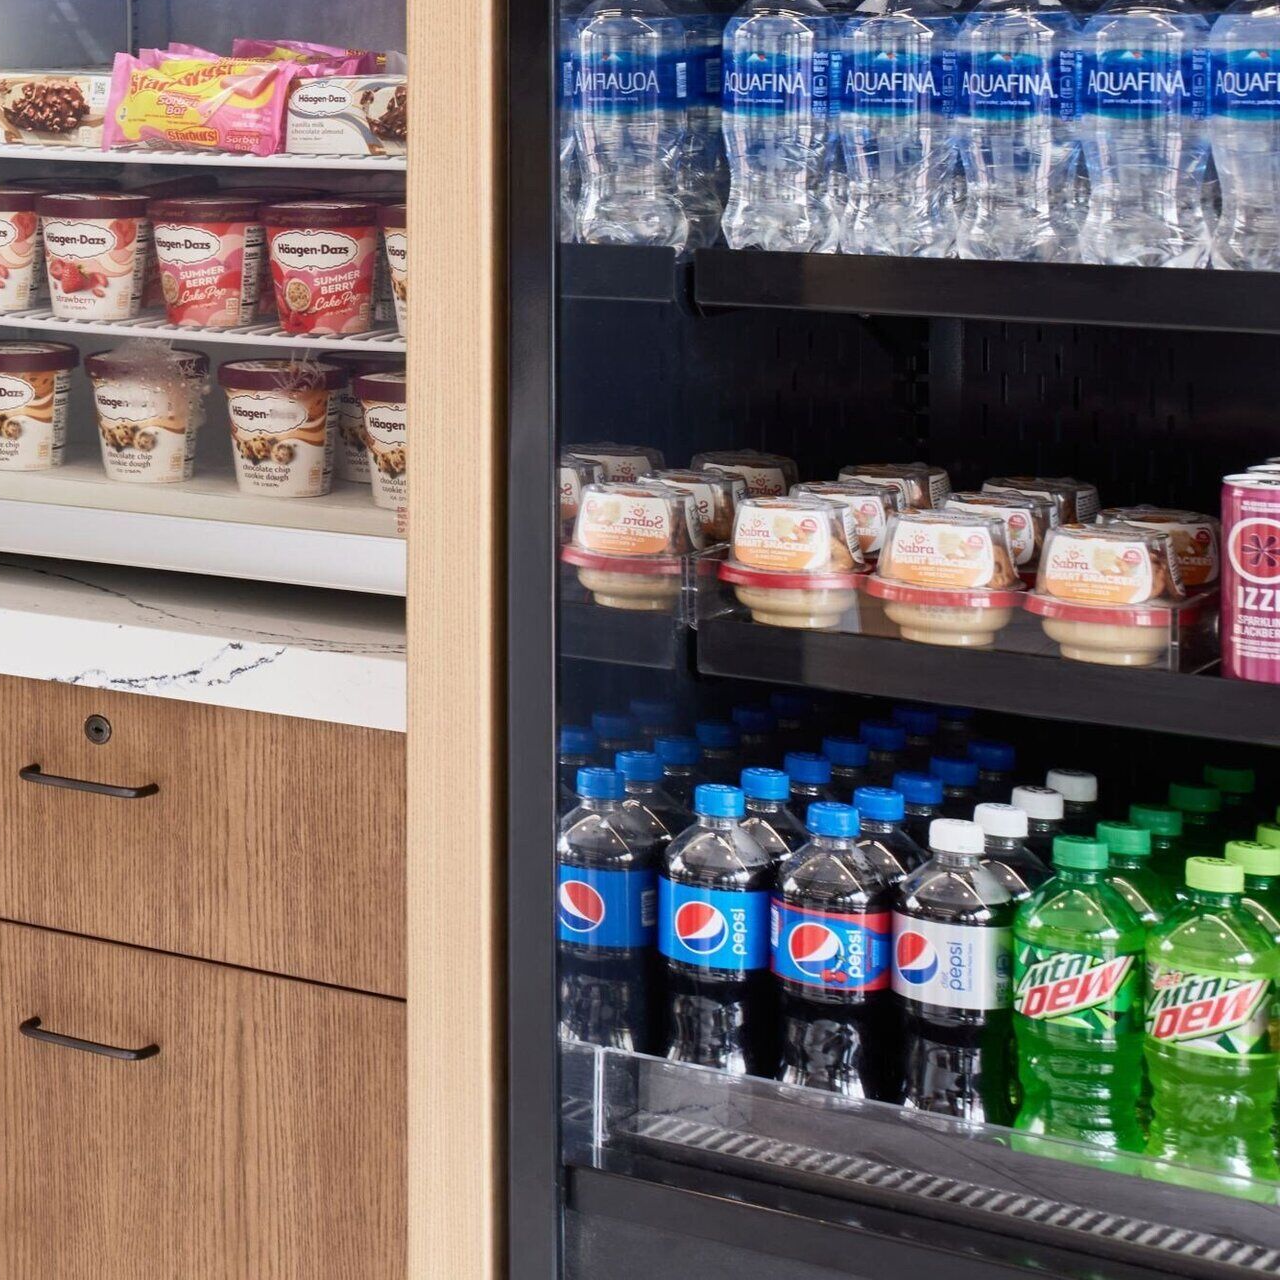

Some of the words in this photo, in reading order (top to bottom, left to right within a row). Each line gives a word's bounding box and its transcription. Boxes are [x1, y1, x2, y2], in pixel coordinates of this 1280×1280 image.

[725, 72, 806, 97] AQUAFINA
[845, 70, 936, 97] AQUAFINA
[962, 71, 1054, 99] AQUAFINA
[1087, 69, 1186, 97] AQUAFINA
[1215, 70, 1280, 97] AQUAFI
[298, 94, 347, 105] Häagen-Dazs
[46, 232, 106, 246] Häagen-Dazs
[277, 243, 349, 255] Häagen-Dazs
[179, 266, 225, 280] SUMMER
[313, 270, 361, 286] SUMMER
[186, 277, 219, 288] BERRY
[321, 281, 355, 294] BERRY
[56, 296, 97, 305] strawberry
[179, 290, 206, 304] Cake
[314, 296, 341, 310] Cake
[5, 440, 20, 450] chip
[137, 452, 152, 462] chip
[242, 464, 273, 473] chocolate
[274, 465, 291, 474] chip
[244, 472, 264, 480] cookie
[265, 473, 289, 482] dough
[738, 523, 771, 539] Sabra
[897, 538, 934, 555] Sabra
[1051, 554, 1089, 571] Sabra
[1237, 615, 1280, 627] SPARKLIN
[1234, 624, 1280, 639] BLACKBER
[730, 908, 748, 955] pepsi
[847, 930, 865, 978] pepsi
[947, 941, 965, 992] pepsi
